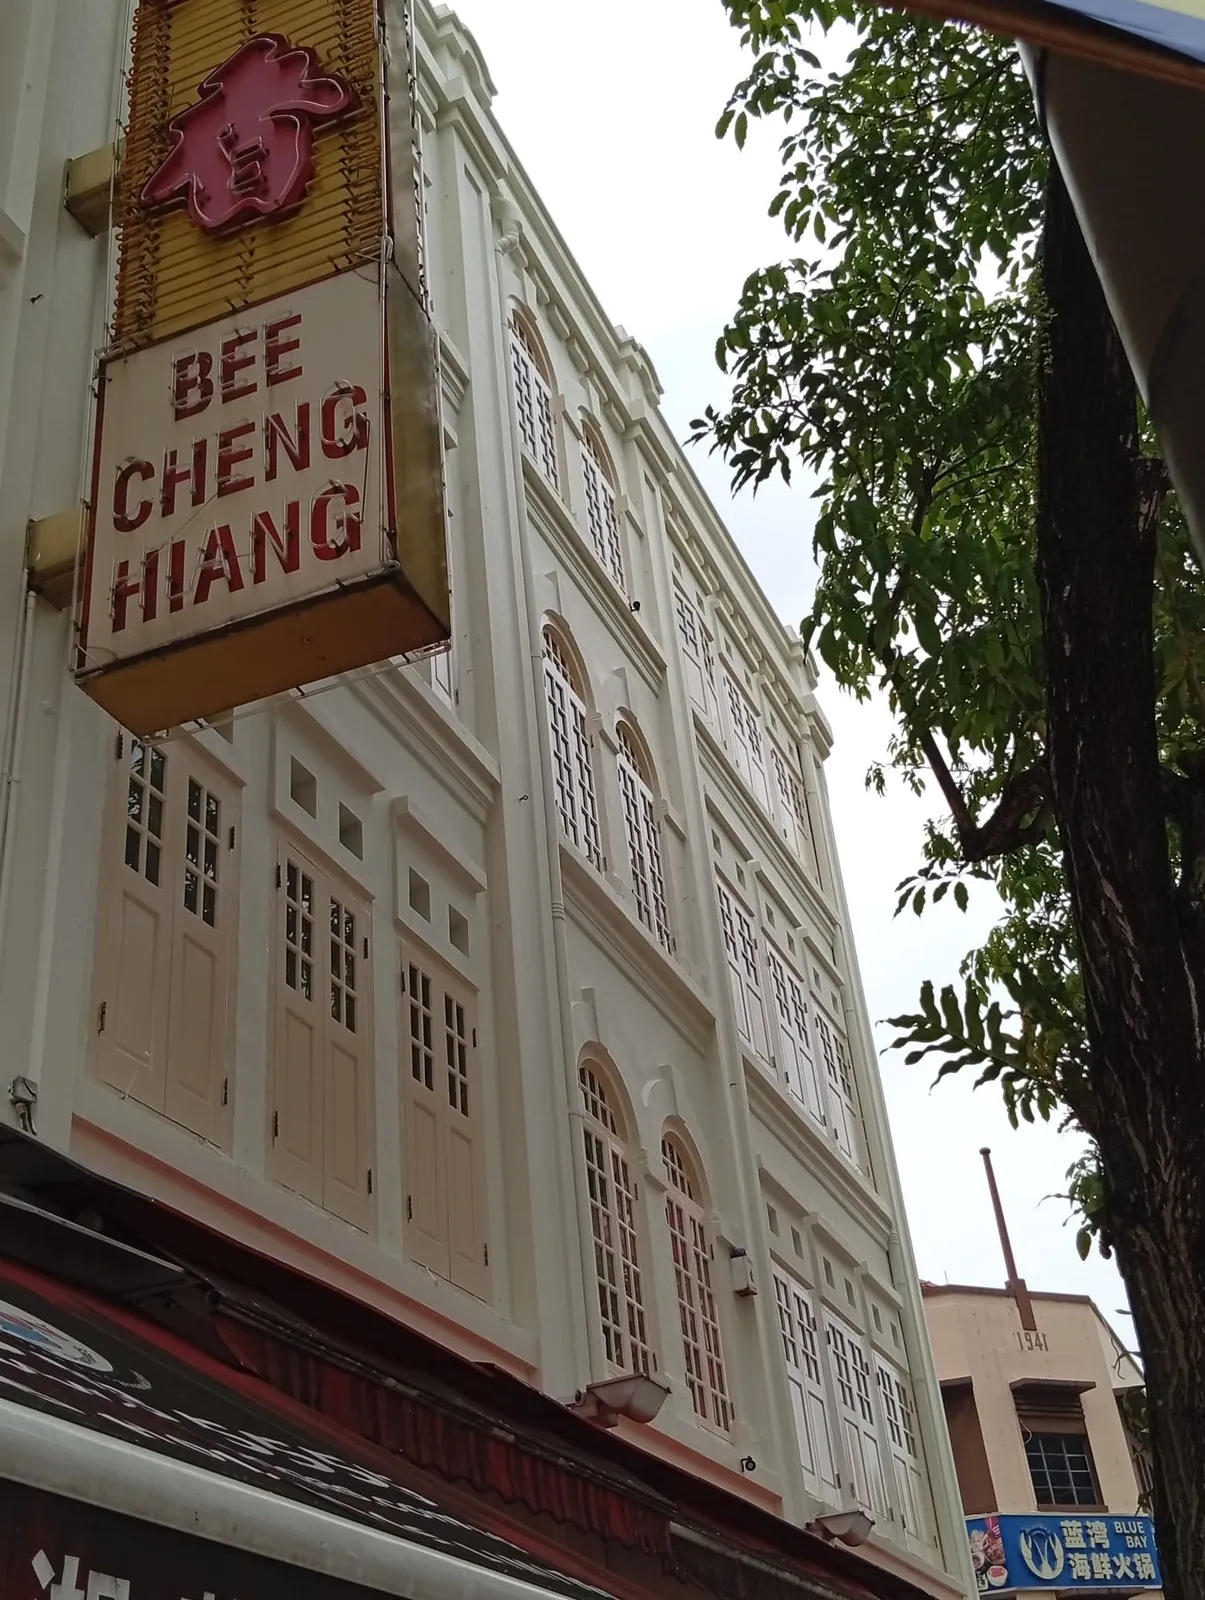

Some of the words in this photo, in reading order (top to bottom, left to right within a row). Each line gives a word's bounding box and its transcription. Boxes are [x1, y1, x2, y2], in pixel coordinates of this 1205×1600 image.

[173, 312, 303, 422] BEE
[112, 383, 369, 532] CHENG
[111, 482, 362, 633] HIANG
[1015, 1331, 1049, 1352] 1941
[1060, 1520, 1110, 1548] 蓝湾
[1114, 1521, 1145, 1534] BLUE
[1126, 1536, 1148, 1548] BAY
[1067, 1552, 1156, 1580] 海鲜火锅
